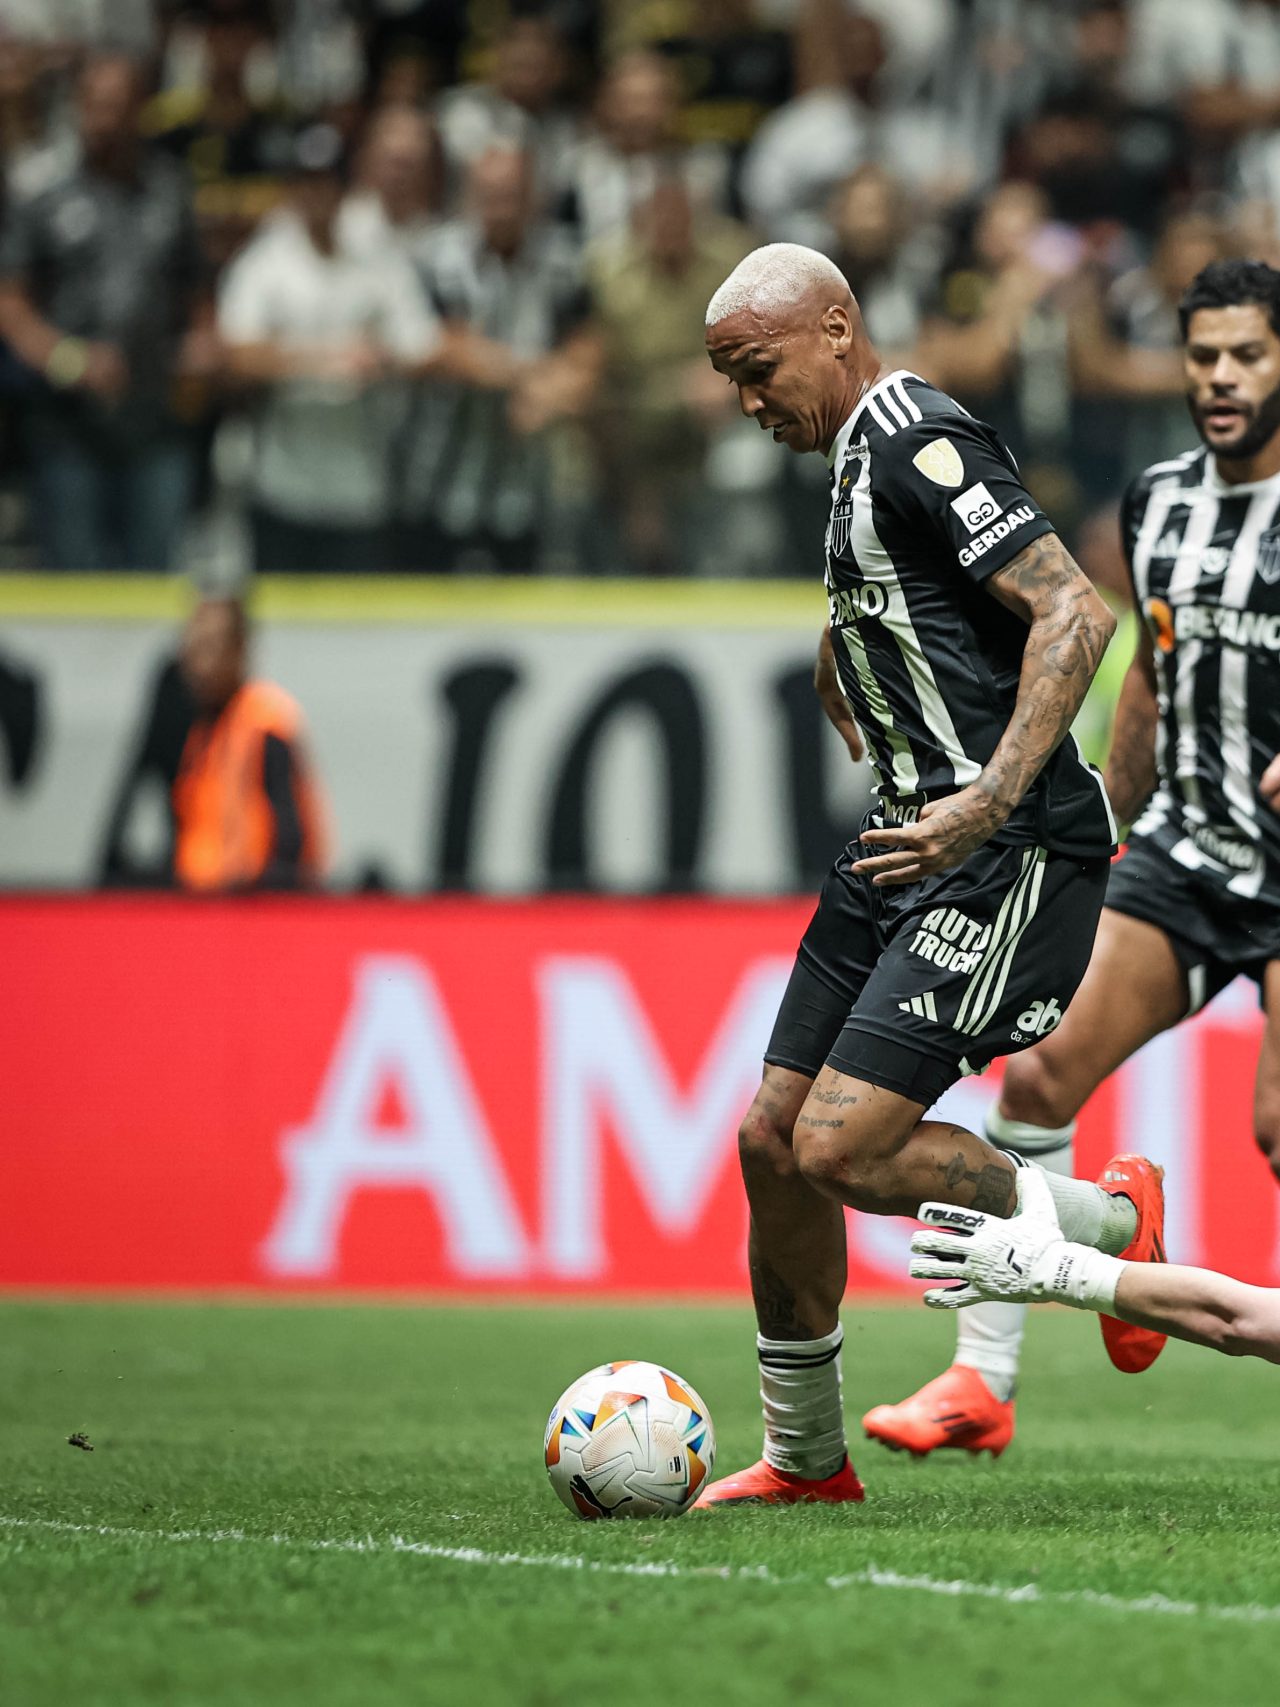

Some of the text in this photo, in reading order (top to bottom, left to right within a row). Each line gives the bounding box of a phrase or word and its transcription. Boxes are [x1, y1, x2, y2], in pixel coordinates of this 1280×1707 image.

[958, 505, 1036, 567] GERDAU
[829, 583, 884, 628] ETANO
[920, 907, 992, 951] AUTO
[908, 930, 983, 975] TRUCK
[924, 1208, 986, 1228] reusch
